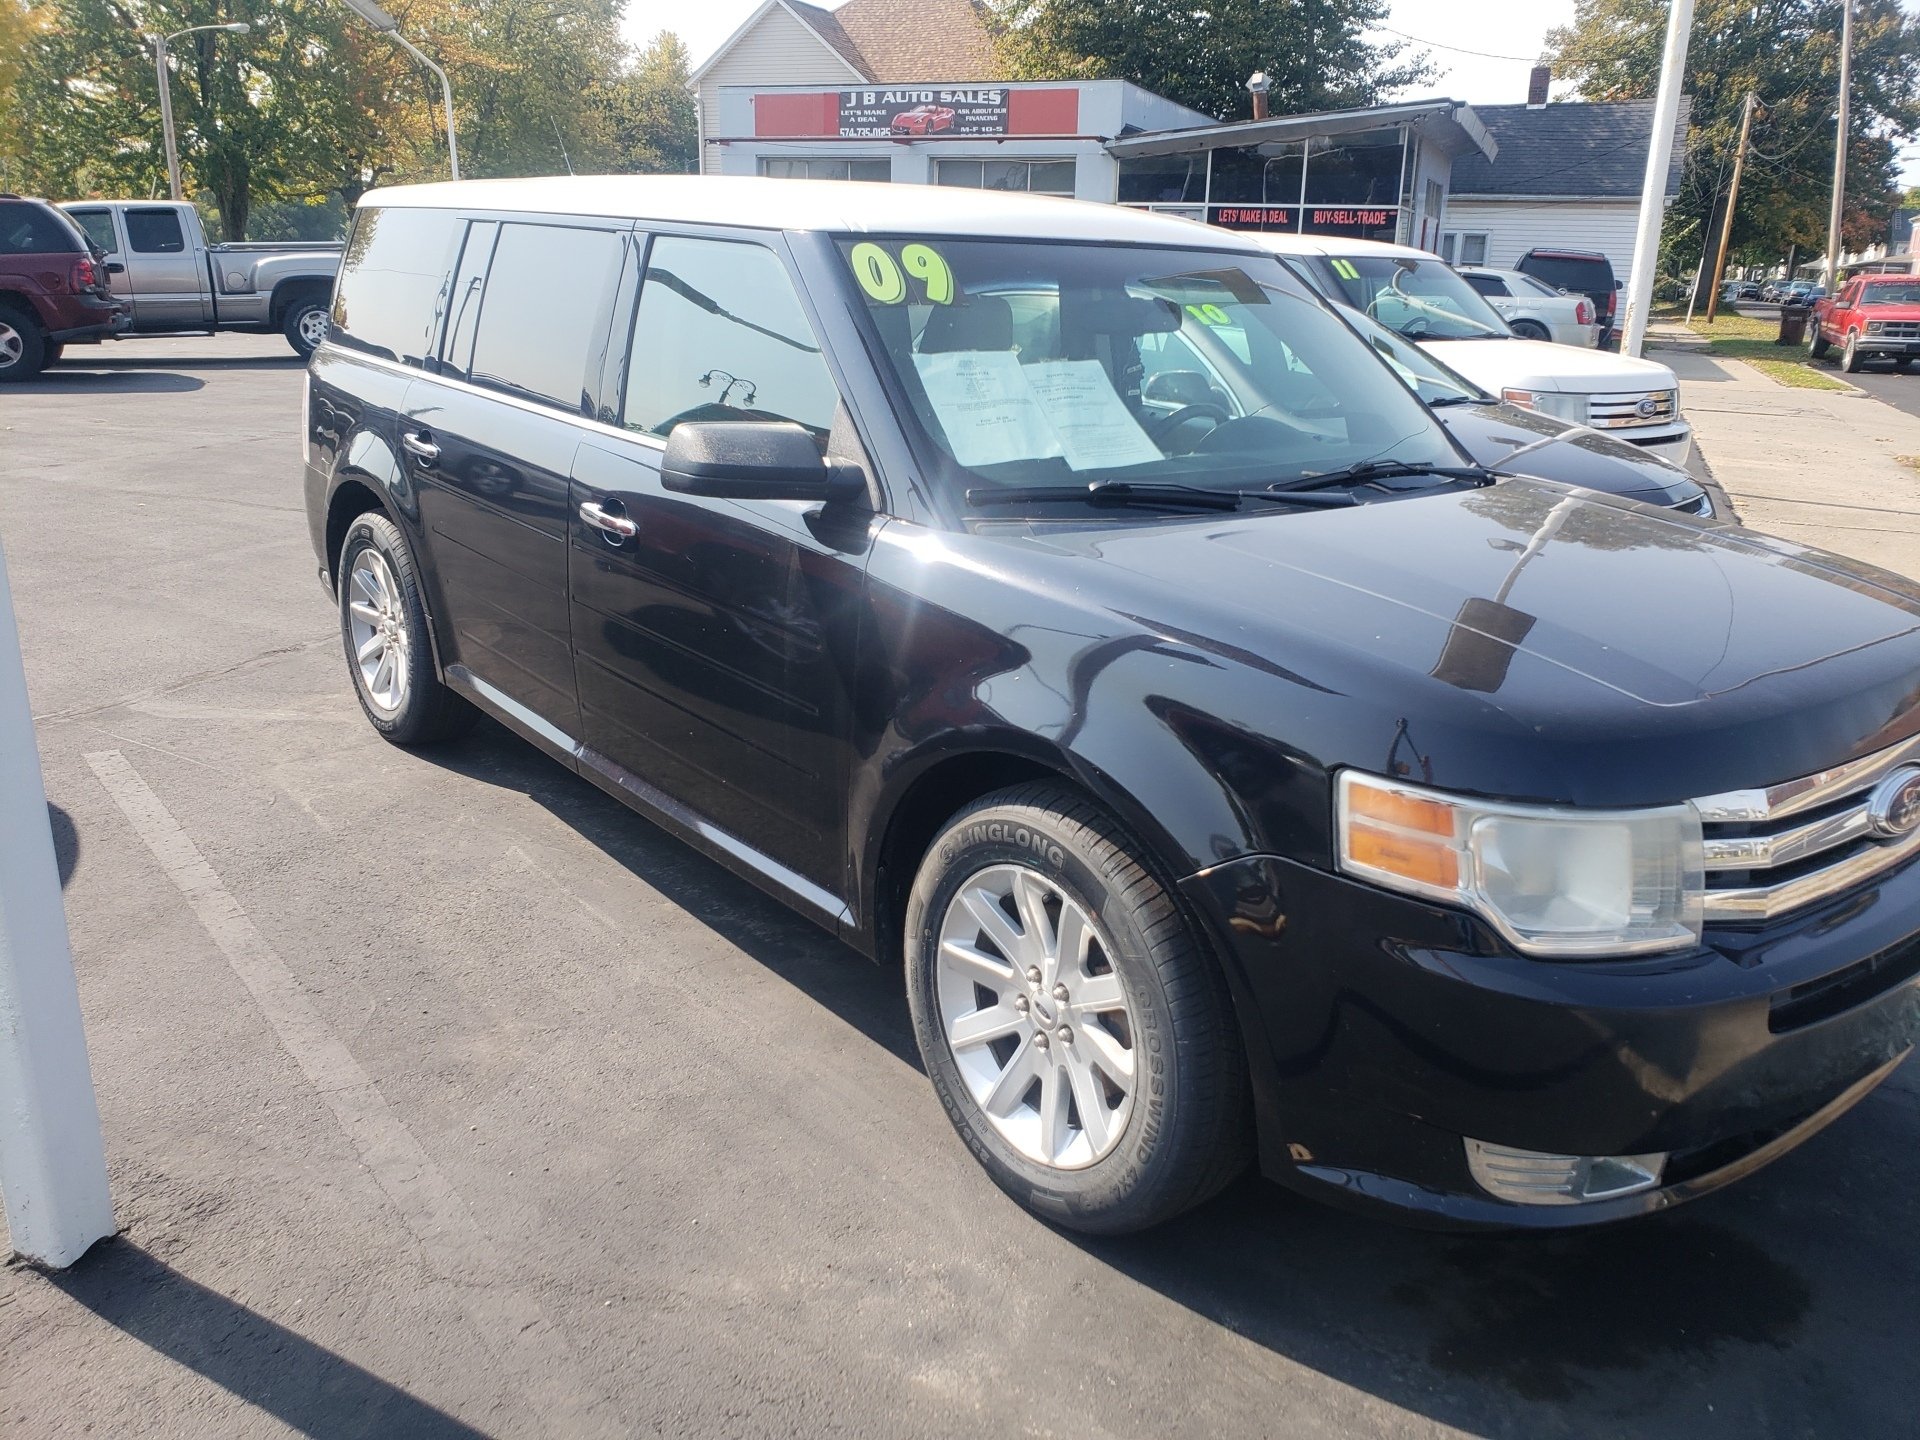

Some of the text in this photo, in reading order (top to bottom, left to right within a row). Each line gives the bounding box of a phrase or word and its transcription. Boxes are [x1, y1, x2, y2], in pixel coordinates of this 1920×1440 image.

[846, 90, 1001, 107] J B AUTO SALES
[1218, 209, 1288, 224] LETS' MAKE A DEAL
[1313, 210, 1387, 225] BUY-SELL-TRADE
[851, 242, 954, 305] 09
[1331, 259, 1361, 280] 11
[1185, 303, 1231, 325] 10
[957, 823, 1064, 869] LINGLONG
